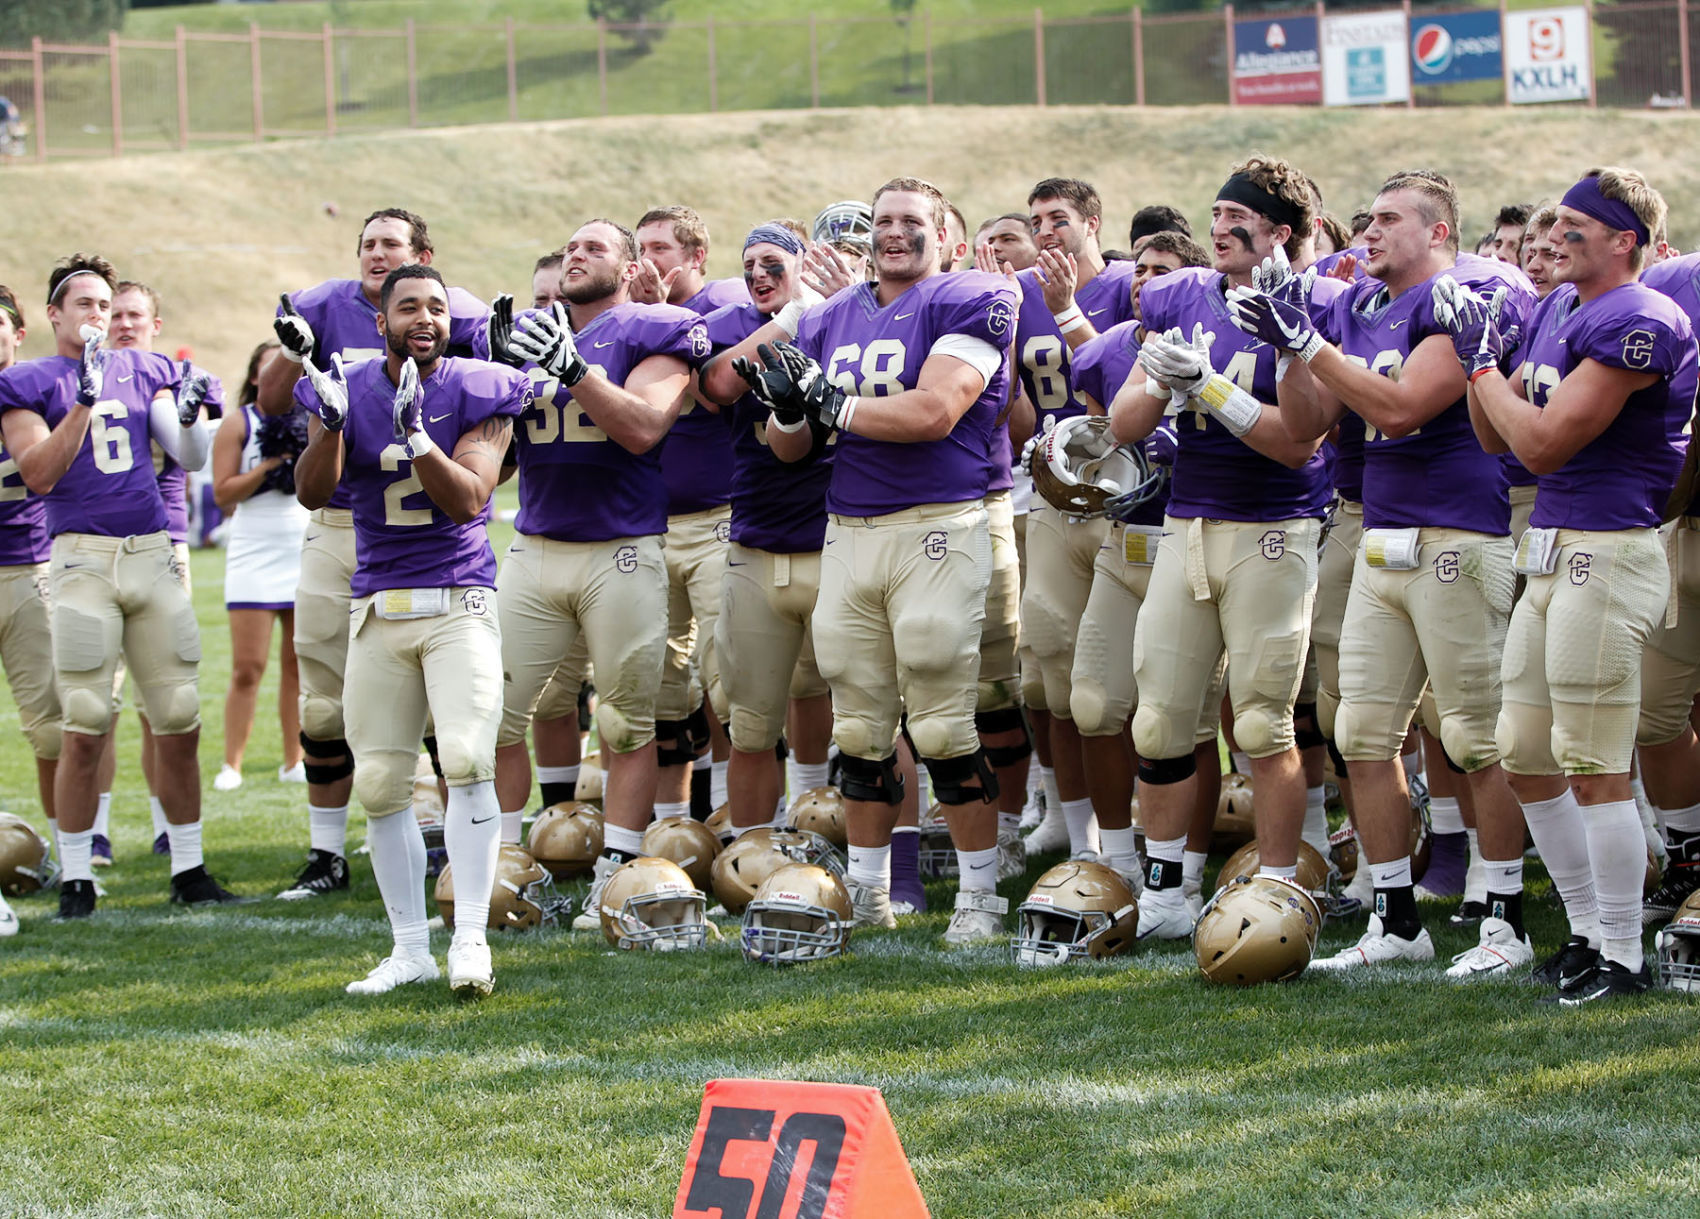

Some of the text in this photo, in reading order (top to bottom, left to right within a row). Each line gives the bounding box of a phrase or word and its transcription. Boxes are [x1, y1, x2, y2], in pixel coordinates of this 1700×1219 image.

[1511, 64, 1578, 89] KXLH
[525, 364, 608, 444] 32
[826, 339, 907, 397] 68
[91, 399, 134, 474] 6
[380, 444, 434, 526] 2
[779, 892, 800, 900] Riddell
[685, 1106, 846, 1219] 50
